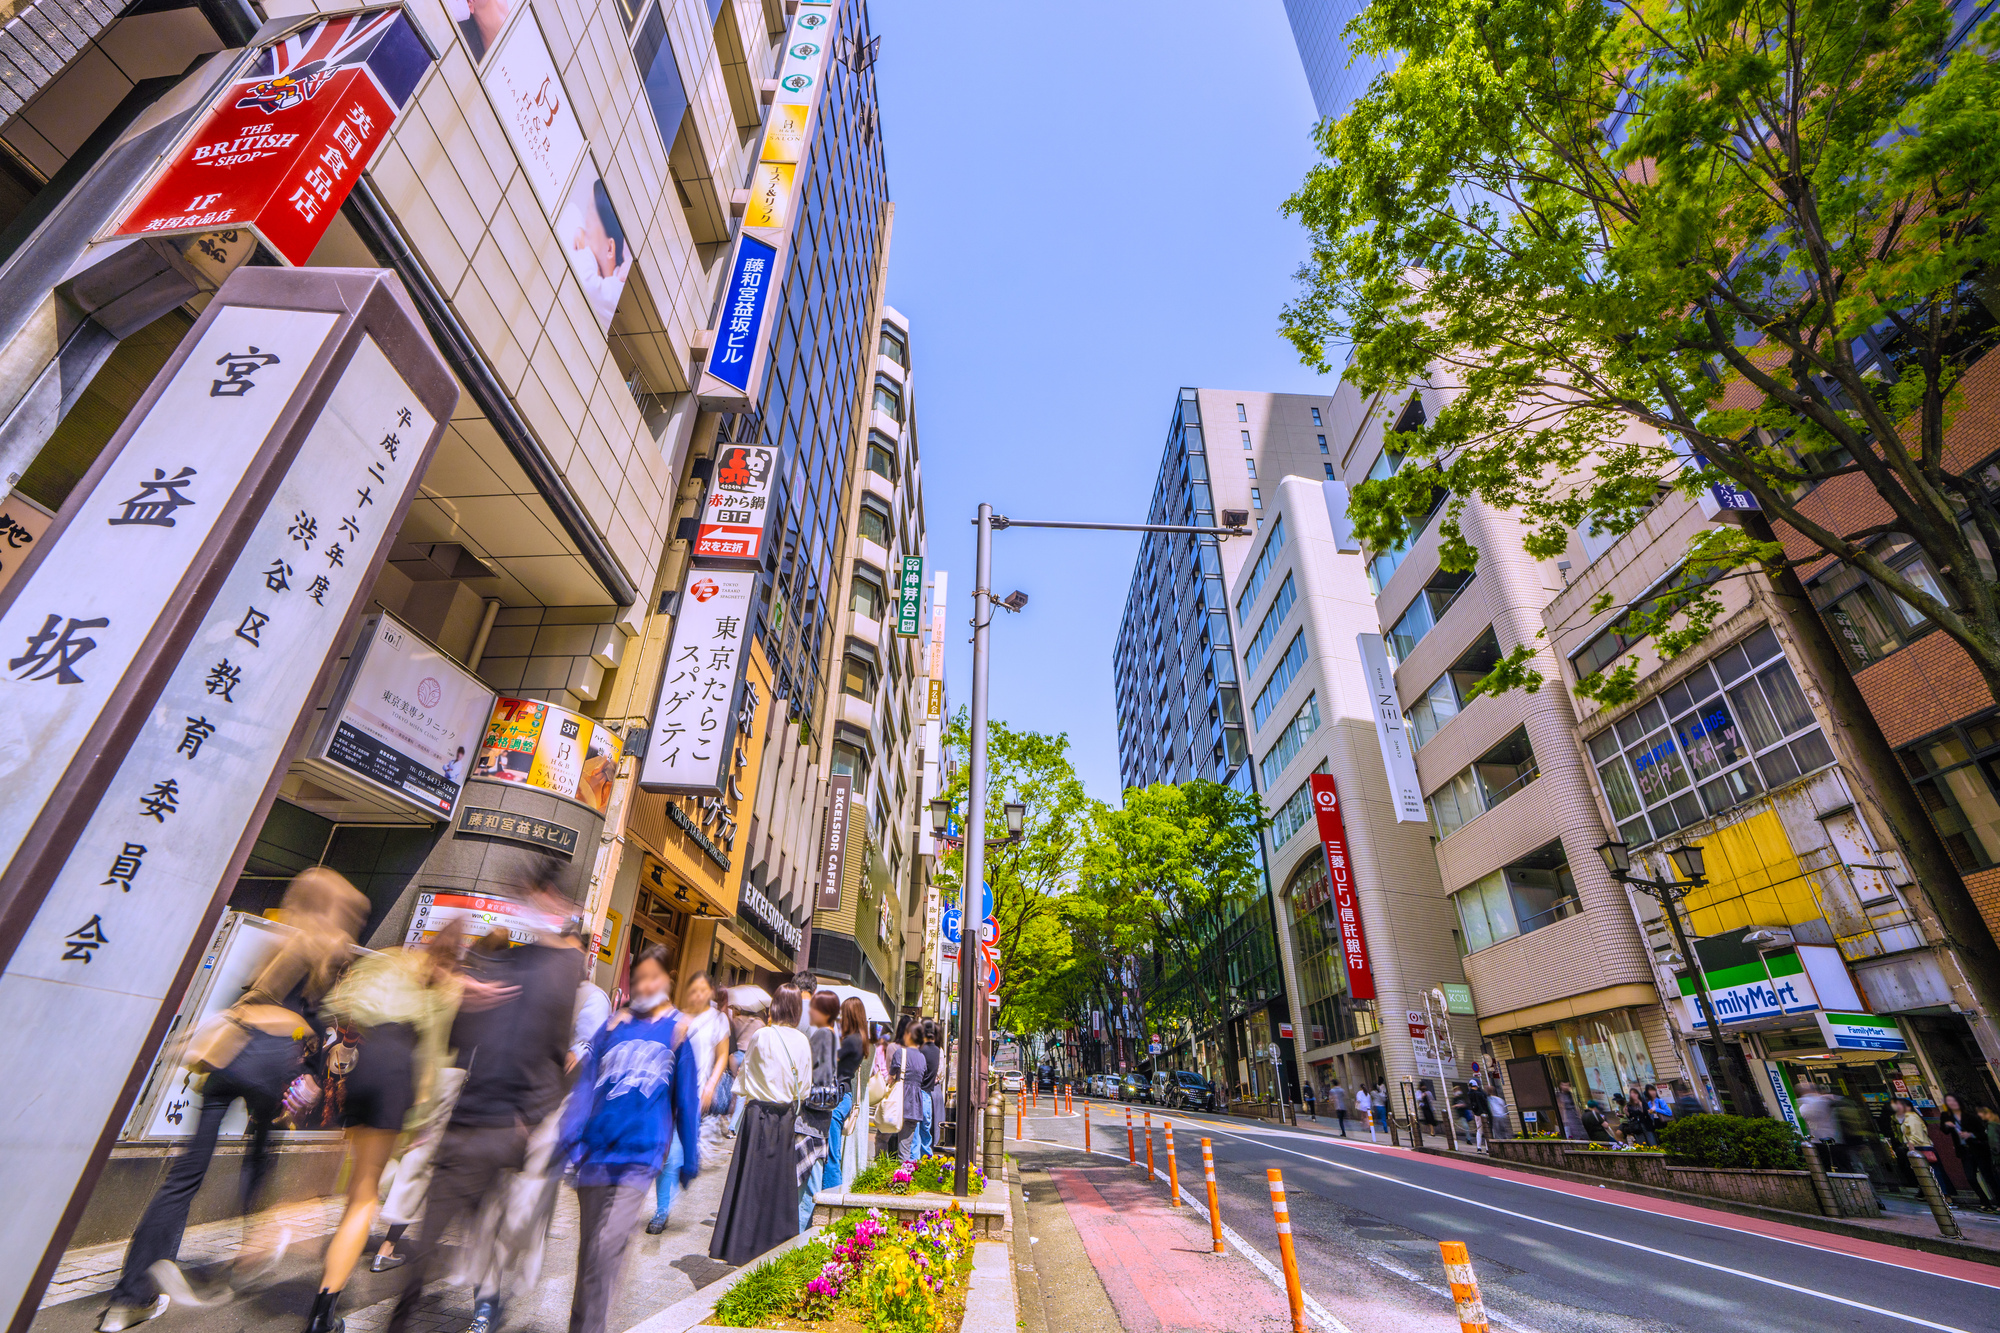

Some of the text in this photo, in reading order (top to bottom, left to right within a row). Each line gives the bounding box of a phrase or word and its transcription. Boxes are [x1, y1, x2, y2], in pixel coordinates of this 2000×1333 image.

[240, 123, 274, 136] THE
[191, 133, 299, 161] BRITISH
[214, 151, 262, 167] SHOP
[289, 101, 375, 224] 英国食品店
[184, 193, 222, 212] 1F
[141, 208, 236, 232] 英国食品店
[721, 258, 765, 364] 藤和宮益坂ビル
[8, 346, 281, 684] 宮益坂
[305, 406, 412, 607] 平成二十六年度
[708, 494, 766, 510] 赤から鍋
[719, 511, 749, 522] B1F
[699, 540, 744, 554] 次を左折
[903, 572, 919, 617] 伸芽会
[692, 615, 740, 761] 東京たらこ
[382, 689, 456, 741] 東京美専クリニック
[659, 645, 700, 768] スパゲティ
[61, 510, 317, 964] 渋谷区教育委員会
[392, 711, 408, 725] TOKYO
[424, 731, 439, 743] CLINIC
[491, 723, 538, 739] マッサージ
[562, 723, 578, 736] 3F
[1691, 710, 1726, 741] GOODS
[486, 735, 537, 753] 骨格調整
[537, 769, 574, 787] SALON
[467, 812, 571, 846] 藤和宮益坂ビル
[672, 803, 690, 830] TOKYO
[825, 788, 845, 895] EXCELSIOR CAFFÉ
[745, 881, 784, 936] EXCELSIOR
[1329, 841, 1363, 970] 三菱UFJ信託銀行
[948, 917, 959, 938] P
[1448, 994, 1468, 1003] KOU
[1694, 981, 1798, 1019] FmilyMart
[1847, 1026, 1885, 1036] FamilyMart
